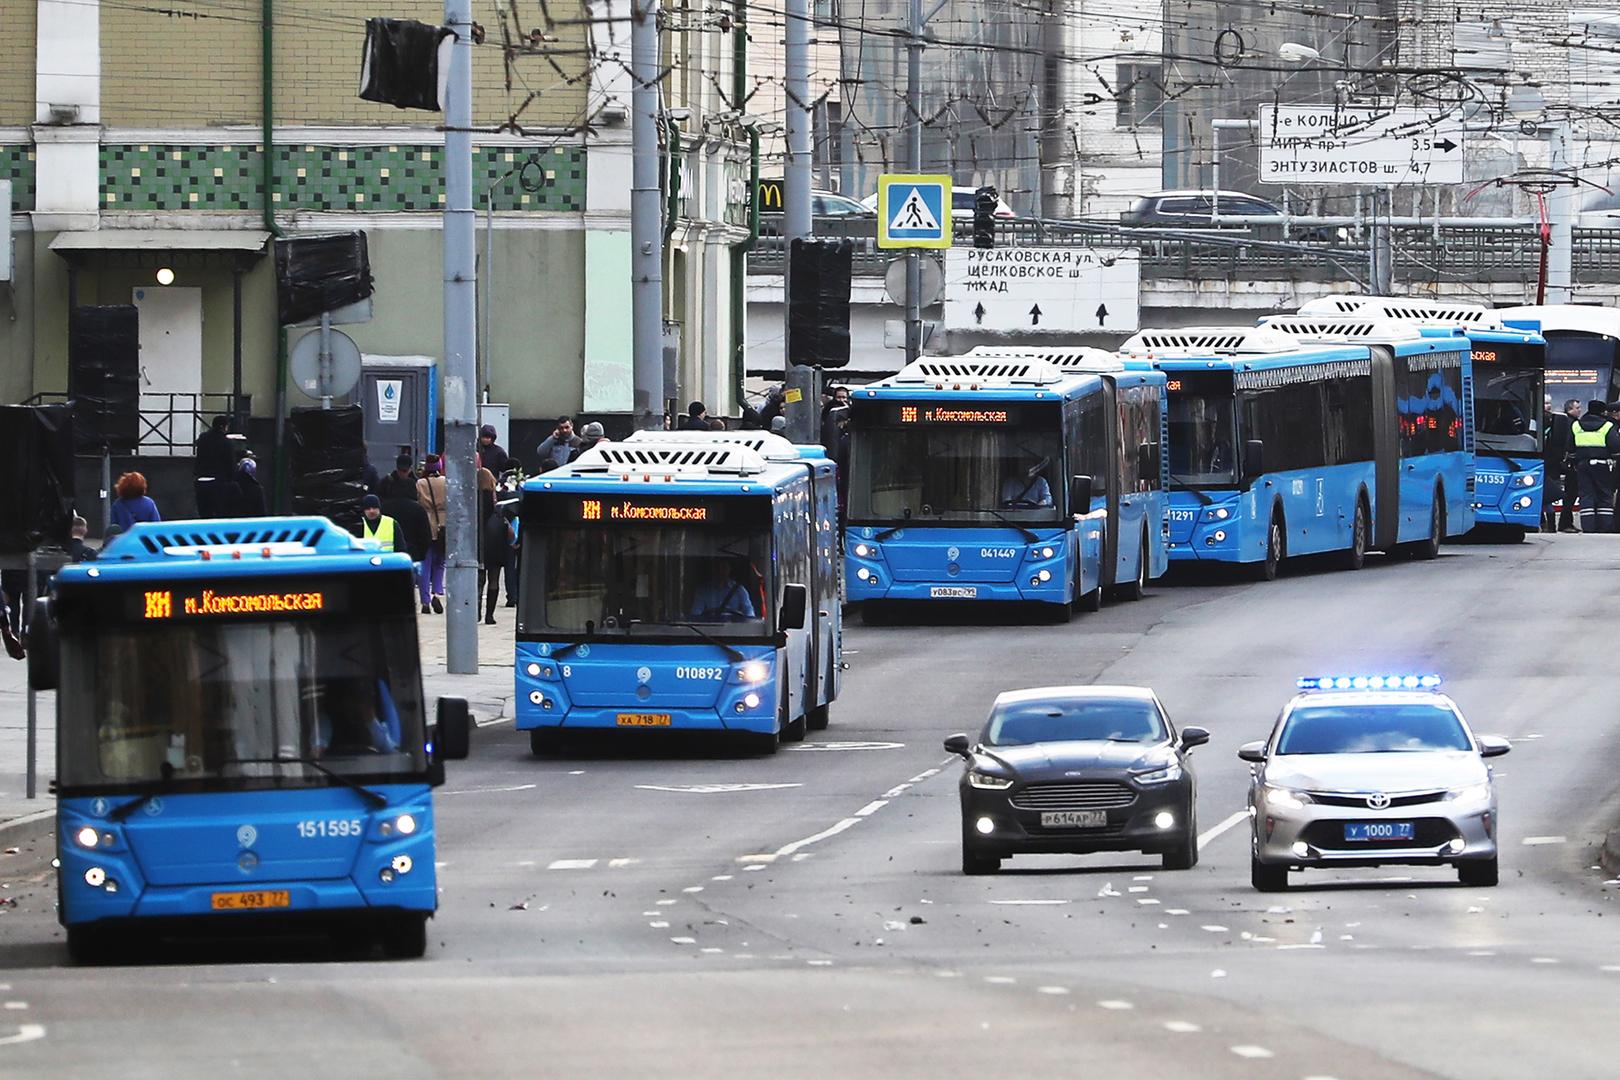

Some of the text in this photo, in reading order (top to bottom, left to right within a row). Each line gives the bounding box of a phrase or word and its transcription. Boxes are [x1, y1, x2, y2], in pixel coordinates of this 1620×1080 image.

[1270, 160, 1378, 174] ЭНТУЗИАСТОВ
[968, 250, 1071, 262] РУСАКОВСКАЯ
[1168, 510, 1194, 521] 1291
[980, 548, 1016, 559] 041449
[184, 590, 323, 614] м.Комсомольская
[563, 666, 572, 677] 8
[676, 667, 722, 681] 010892
[297, 820, 362, 838] 151595
[1363, 824, 1393, 837] 1000
[240, 891, 264, 907] 493
